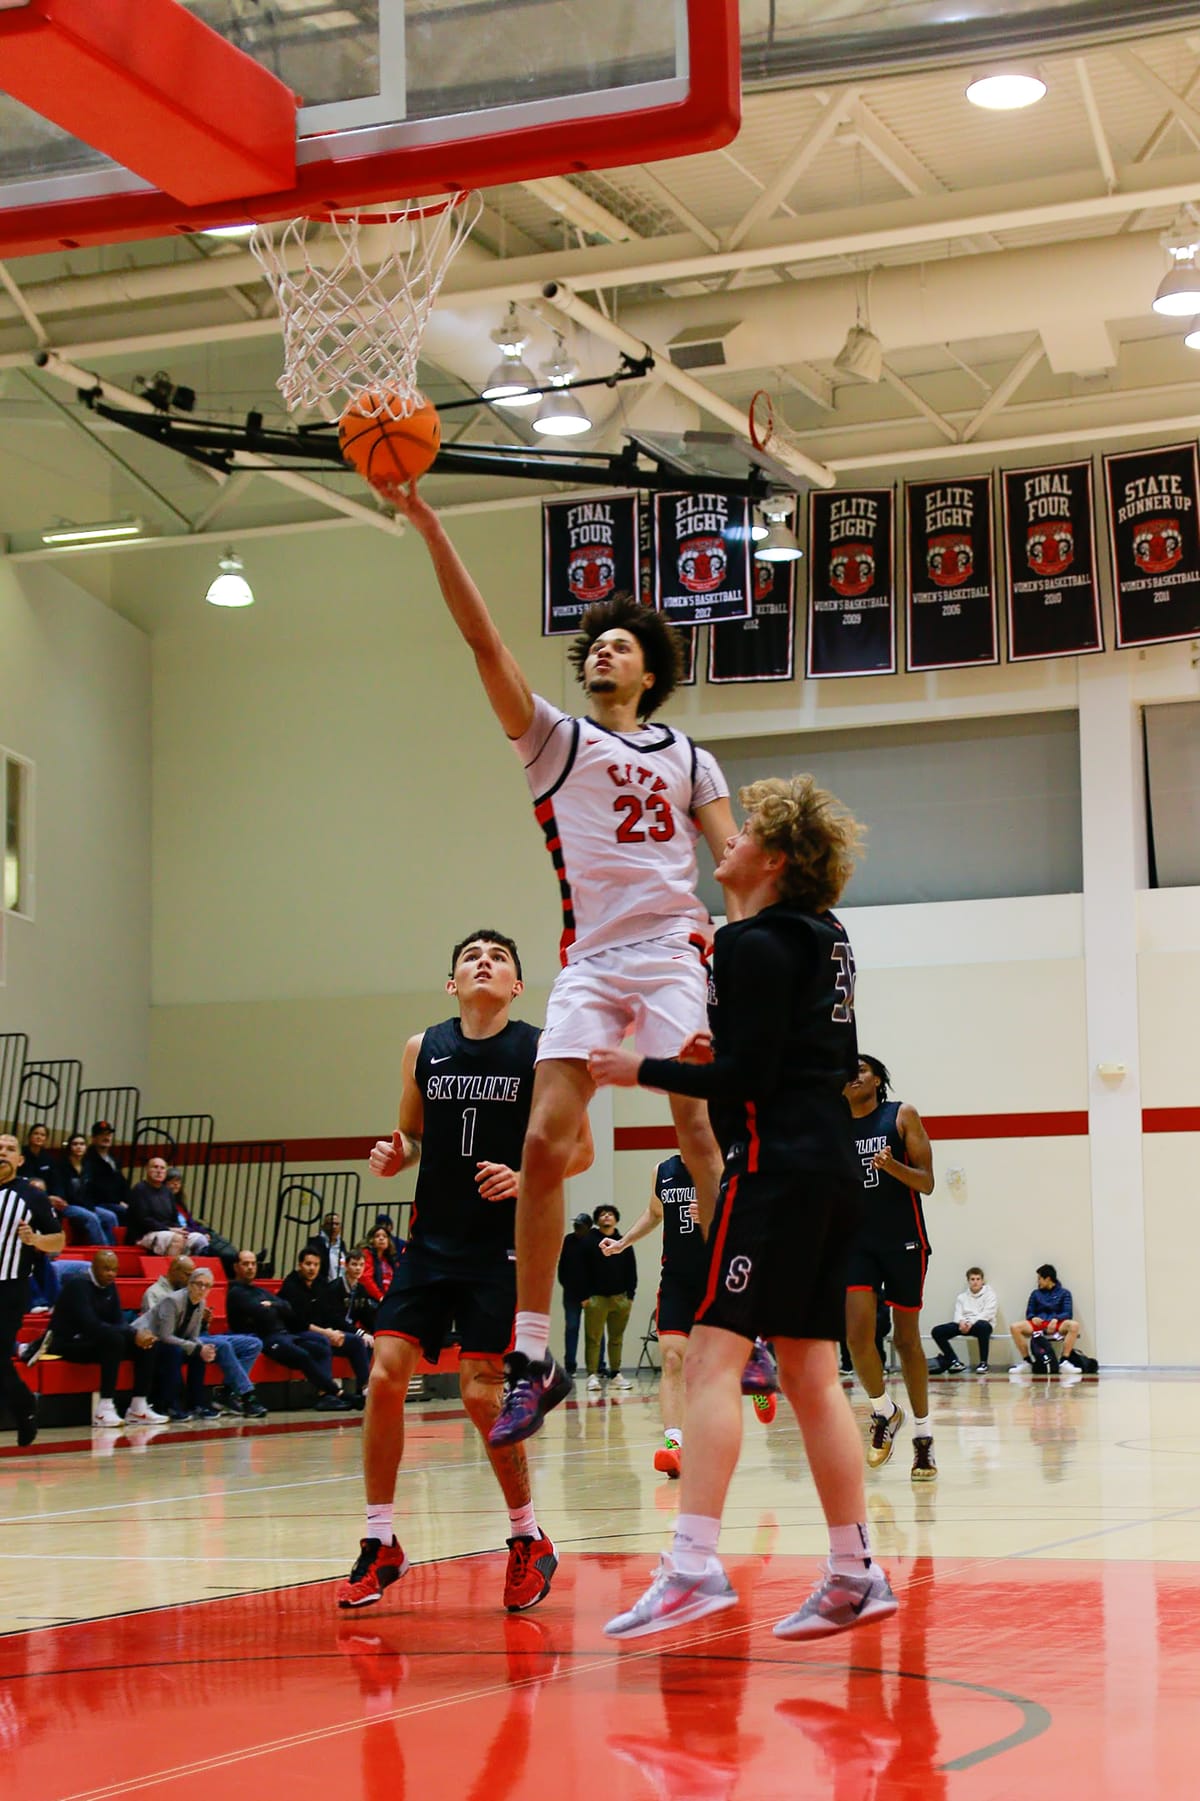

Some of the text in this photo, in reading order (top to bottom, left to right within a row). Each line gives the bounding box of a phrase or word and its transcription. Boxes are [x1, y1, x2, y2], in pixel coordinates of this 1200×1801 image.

[925, 488, 974, 512] ELITE
[1025, 474, 1072, 501] FINAL
[1125, 475, 1182, 503] STATE
[567, 503, 615, 529] FINAL
[675, 494, 728, 520] ELITE
[830, 498, 878, 522] ELITE
[1028, 496, 1070, 522] FOUR
[1118, 496, 1192, 524] RUNNER UP
[675, 513, 728, 540] EIGHT
[829, 518, 877, 542] EIGHT
[925, 508, 974, 533] EIGHT
[570, 524, 612, 549] FOUR
[943, 585, 990, 602] BASKETBALL
[1044, 573, 1092, 590] BASKETBALL
[694, 589, 743, 606] BASKETBALL
[844, 595, 889, 611] BASKETBALL
[607, 764, 668, 792] CITY
[613, 793, 675, 844] 23
[427, 1075, 521, 1102] SKYLINE
[462, 1107, 477, 1156] 1
[861, 1157, 880, 1189] 3
[679, 1205, 695, 1234] 5
[725, 1255, 752, 1293] S
